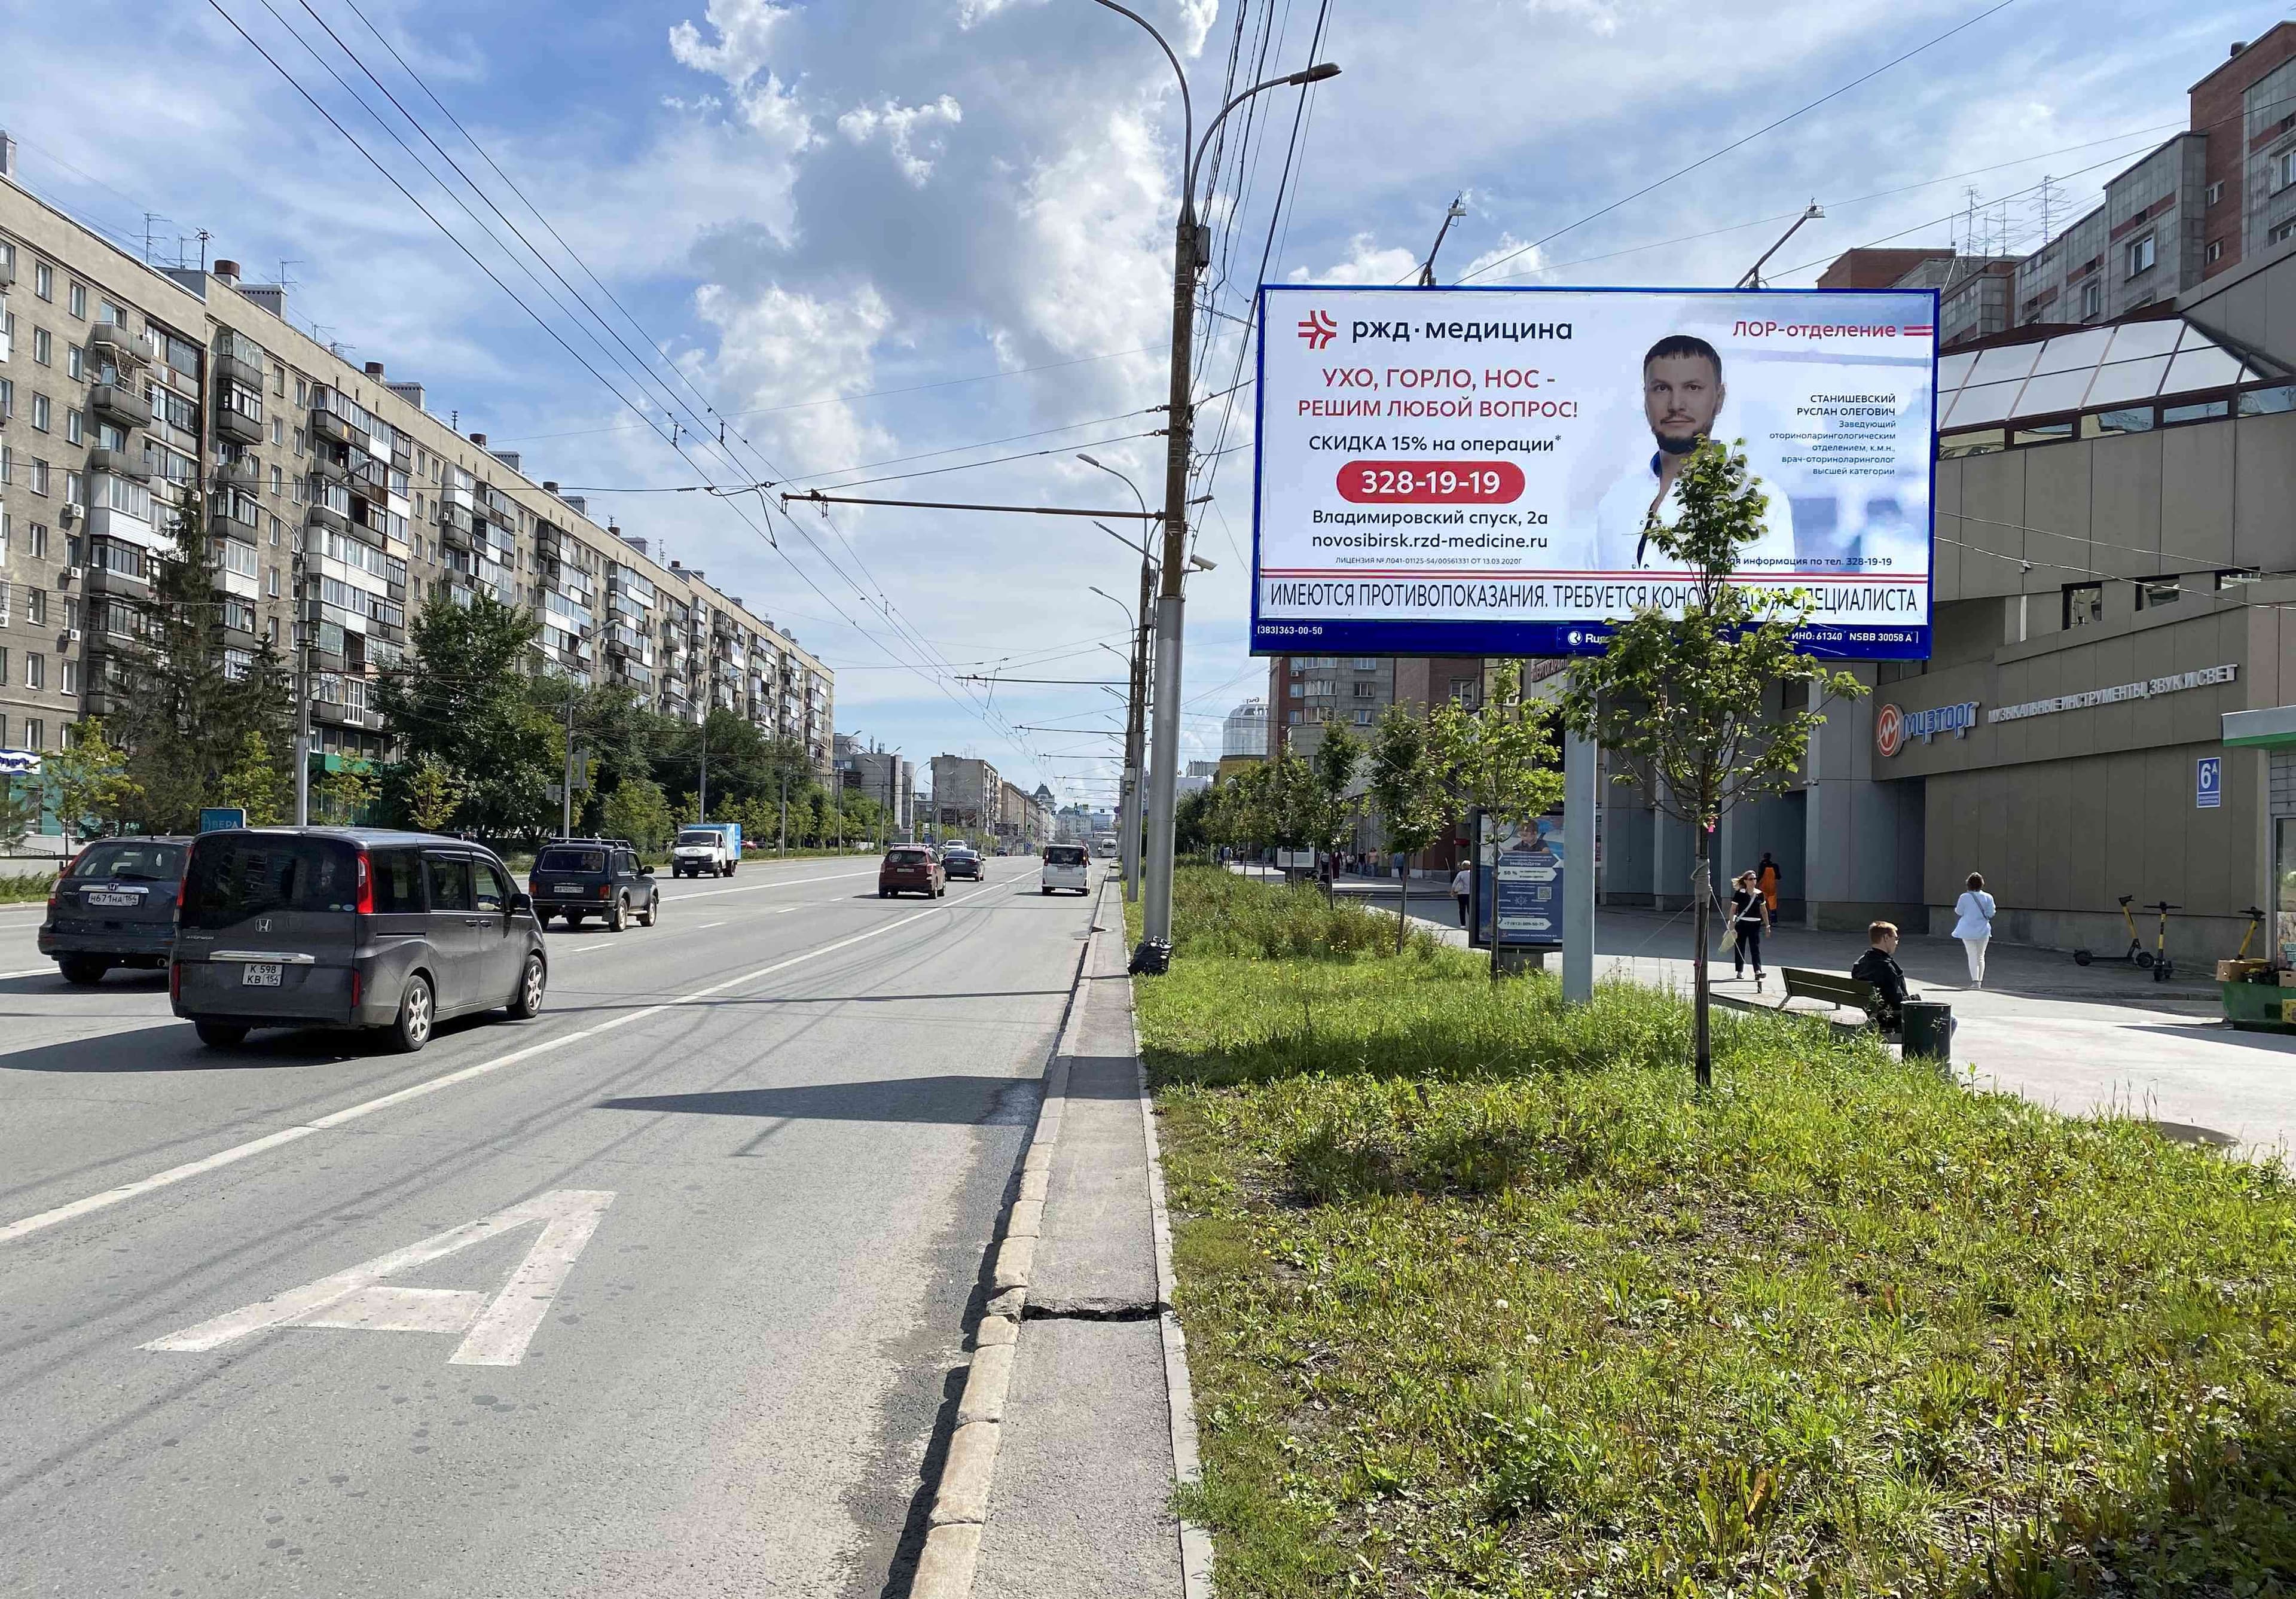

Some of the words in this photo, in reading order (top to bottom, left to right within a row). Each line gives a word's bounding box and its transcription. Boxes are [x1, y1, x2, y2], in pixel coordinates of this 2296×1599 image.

[1733, 321, 1896, 340] ЛОР-отделение
[1322, 368, 1378, 391] УХО,
[1387, 368, 1476, 392] ГОРЛО,
[1485, 369, 1540, 388] НОС
[1810, 393, 1895, 403] СТАНИШЕВСКИЙ
[1299, 399, 1381, 417] РЕШИМ
[1387, 396, 1472, 417] ЛЮБОЙ
[1480, 401, 1577, 418] ВОПРОС!
[1797, 407, 1837, 416] РУСЛАН
[1840, 407, 1895, 416] ОЛЕГОВИЧ
[1839, 420, 1896, 429] Заведующий
[1309, 435, 1387, 453] СКИДКА
[1392, 436, 1427, 451] 15%
[1433, 440, 1455, 451] на
[1781, 456, 1895, 465] врач-оториноларинголог
[1361, 470, 1500, 494] 328-19-19
[1313, 509, 1464, 527] Владимировский
[1469, 514, 1522, 528] спуск,
[1527, 511, 1548, 524] 2а
[1312, 533, 1547, 548] novosibirsk.rzd-medicine.ru
[1744, 557, 1808, 567] информация
[1846, 557, 1892, 566] 328-19-19
[1271, 583, 1354, 606] ИМЕЮТСЯ
[1360, 584, 1548, 608] ПРОТИВОПОКАЗАНИЯ.
[1553, 585, 1646, 609] ТРЕБУЕТСЯ
[1257, 625, 1323, 634] (383)363-00-50
[1816, 632, 1842, 641] 61340
[1878, 633, 1903, 641] 30058
[2150, 675, 2184, 695] ЗВУК
[2185, 672, 2198, 688] И
[2197, 664, 2239, 686] СВЕТ
[260, 965, 277, 974] 598
